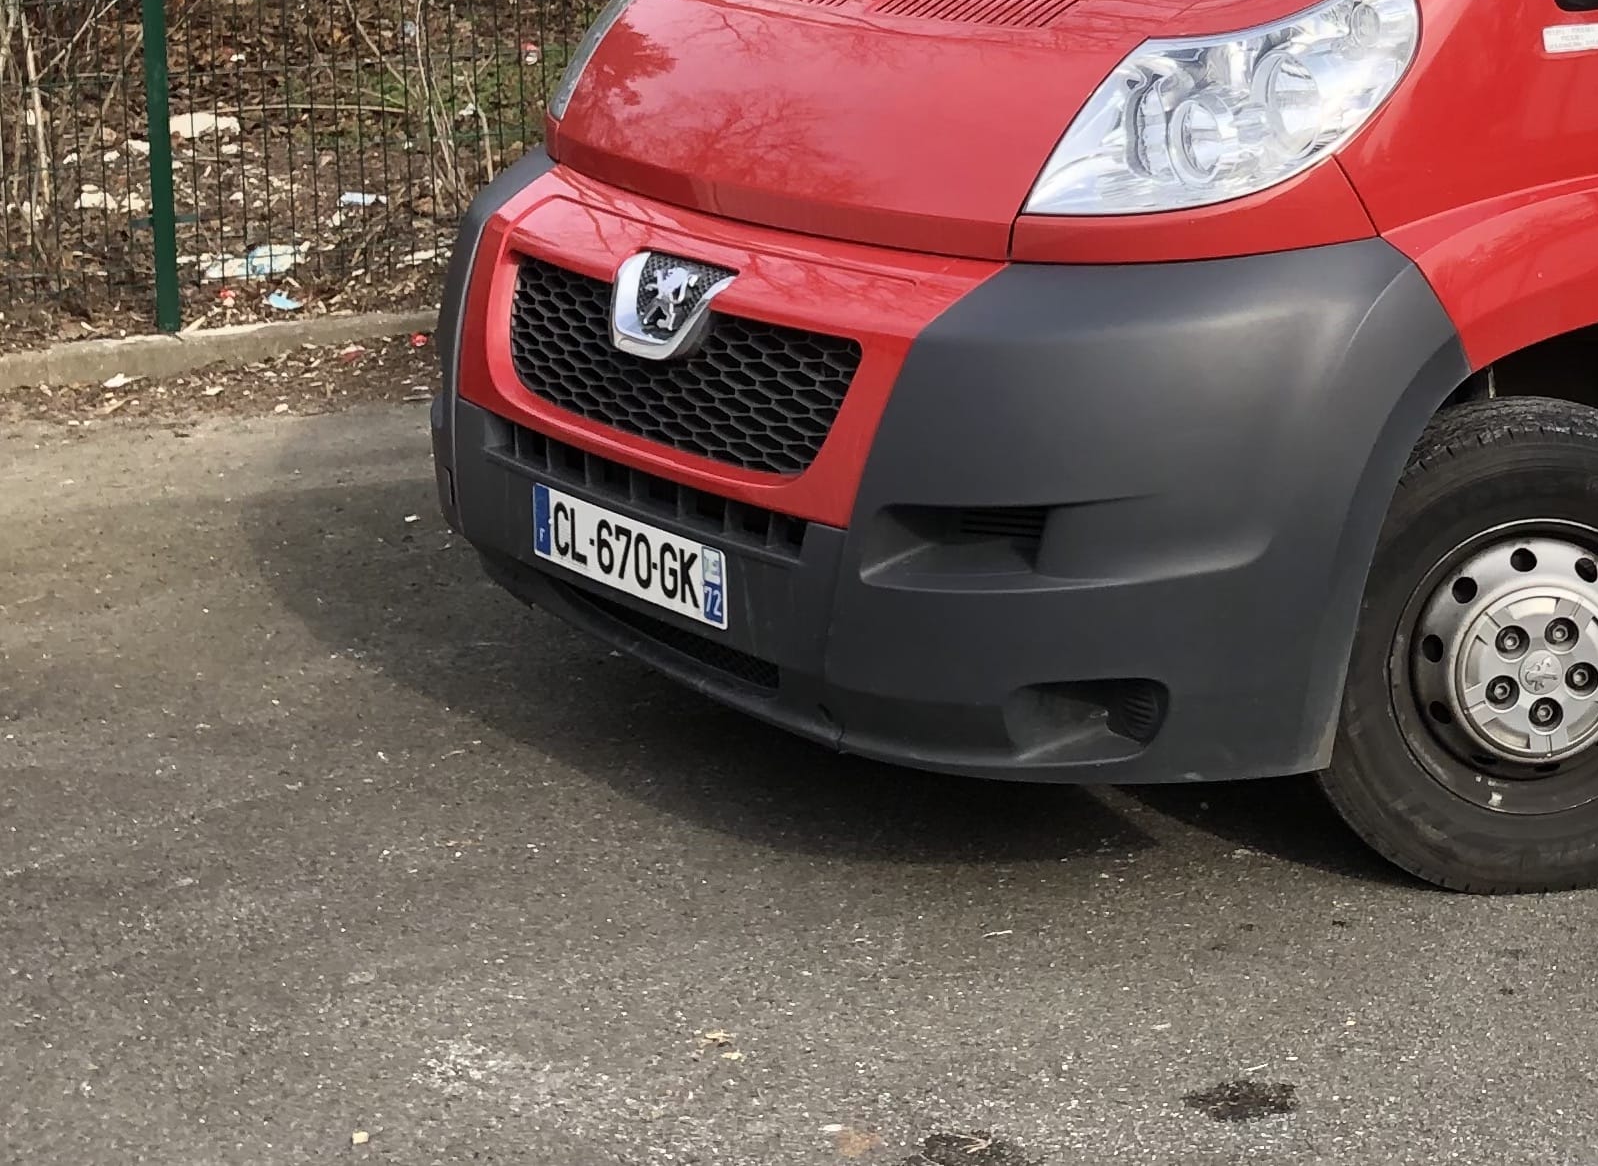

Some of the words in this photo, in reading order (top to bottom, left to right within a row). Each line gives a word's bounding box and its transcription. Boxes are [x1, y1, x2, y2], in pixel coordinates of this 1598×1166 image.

[539, 528, 546, 542] F
[553, 501, 700, 609] CL-670-GK
[703, 587, 722, 618] 72
